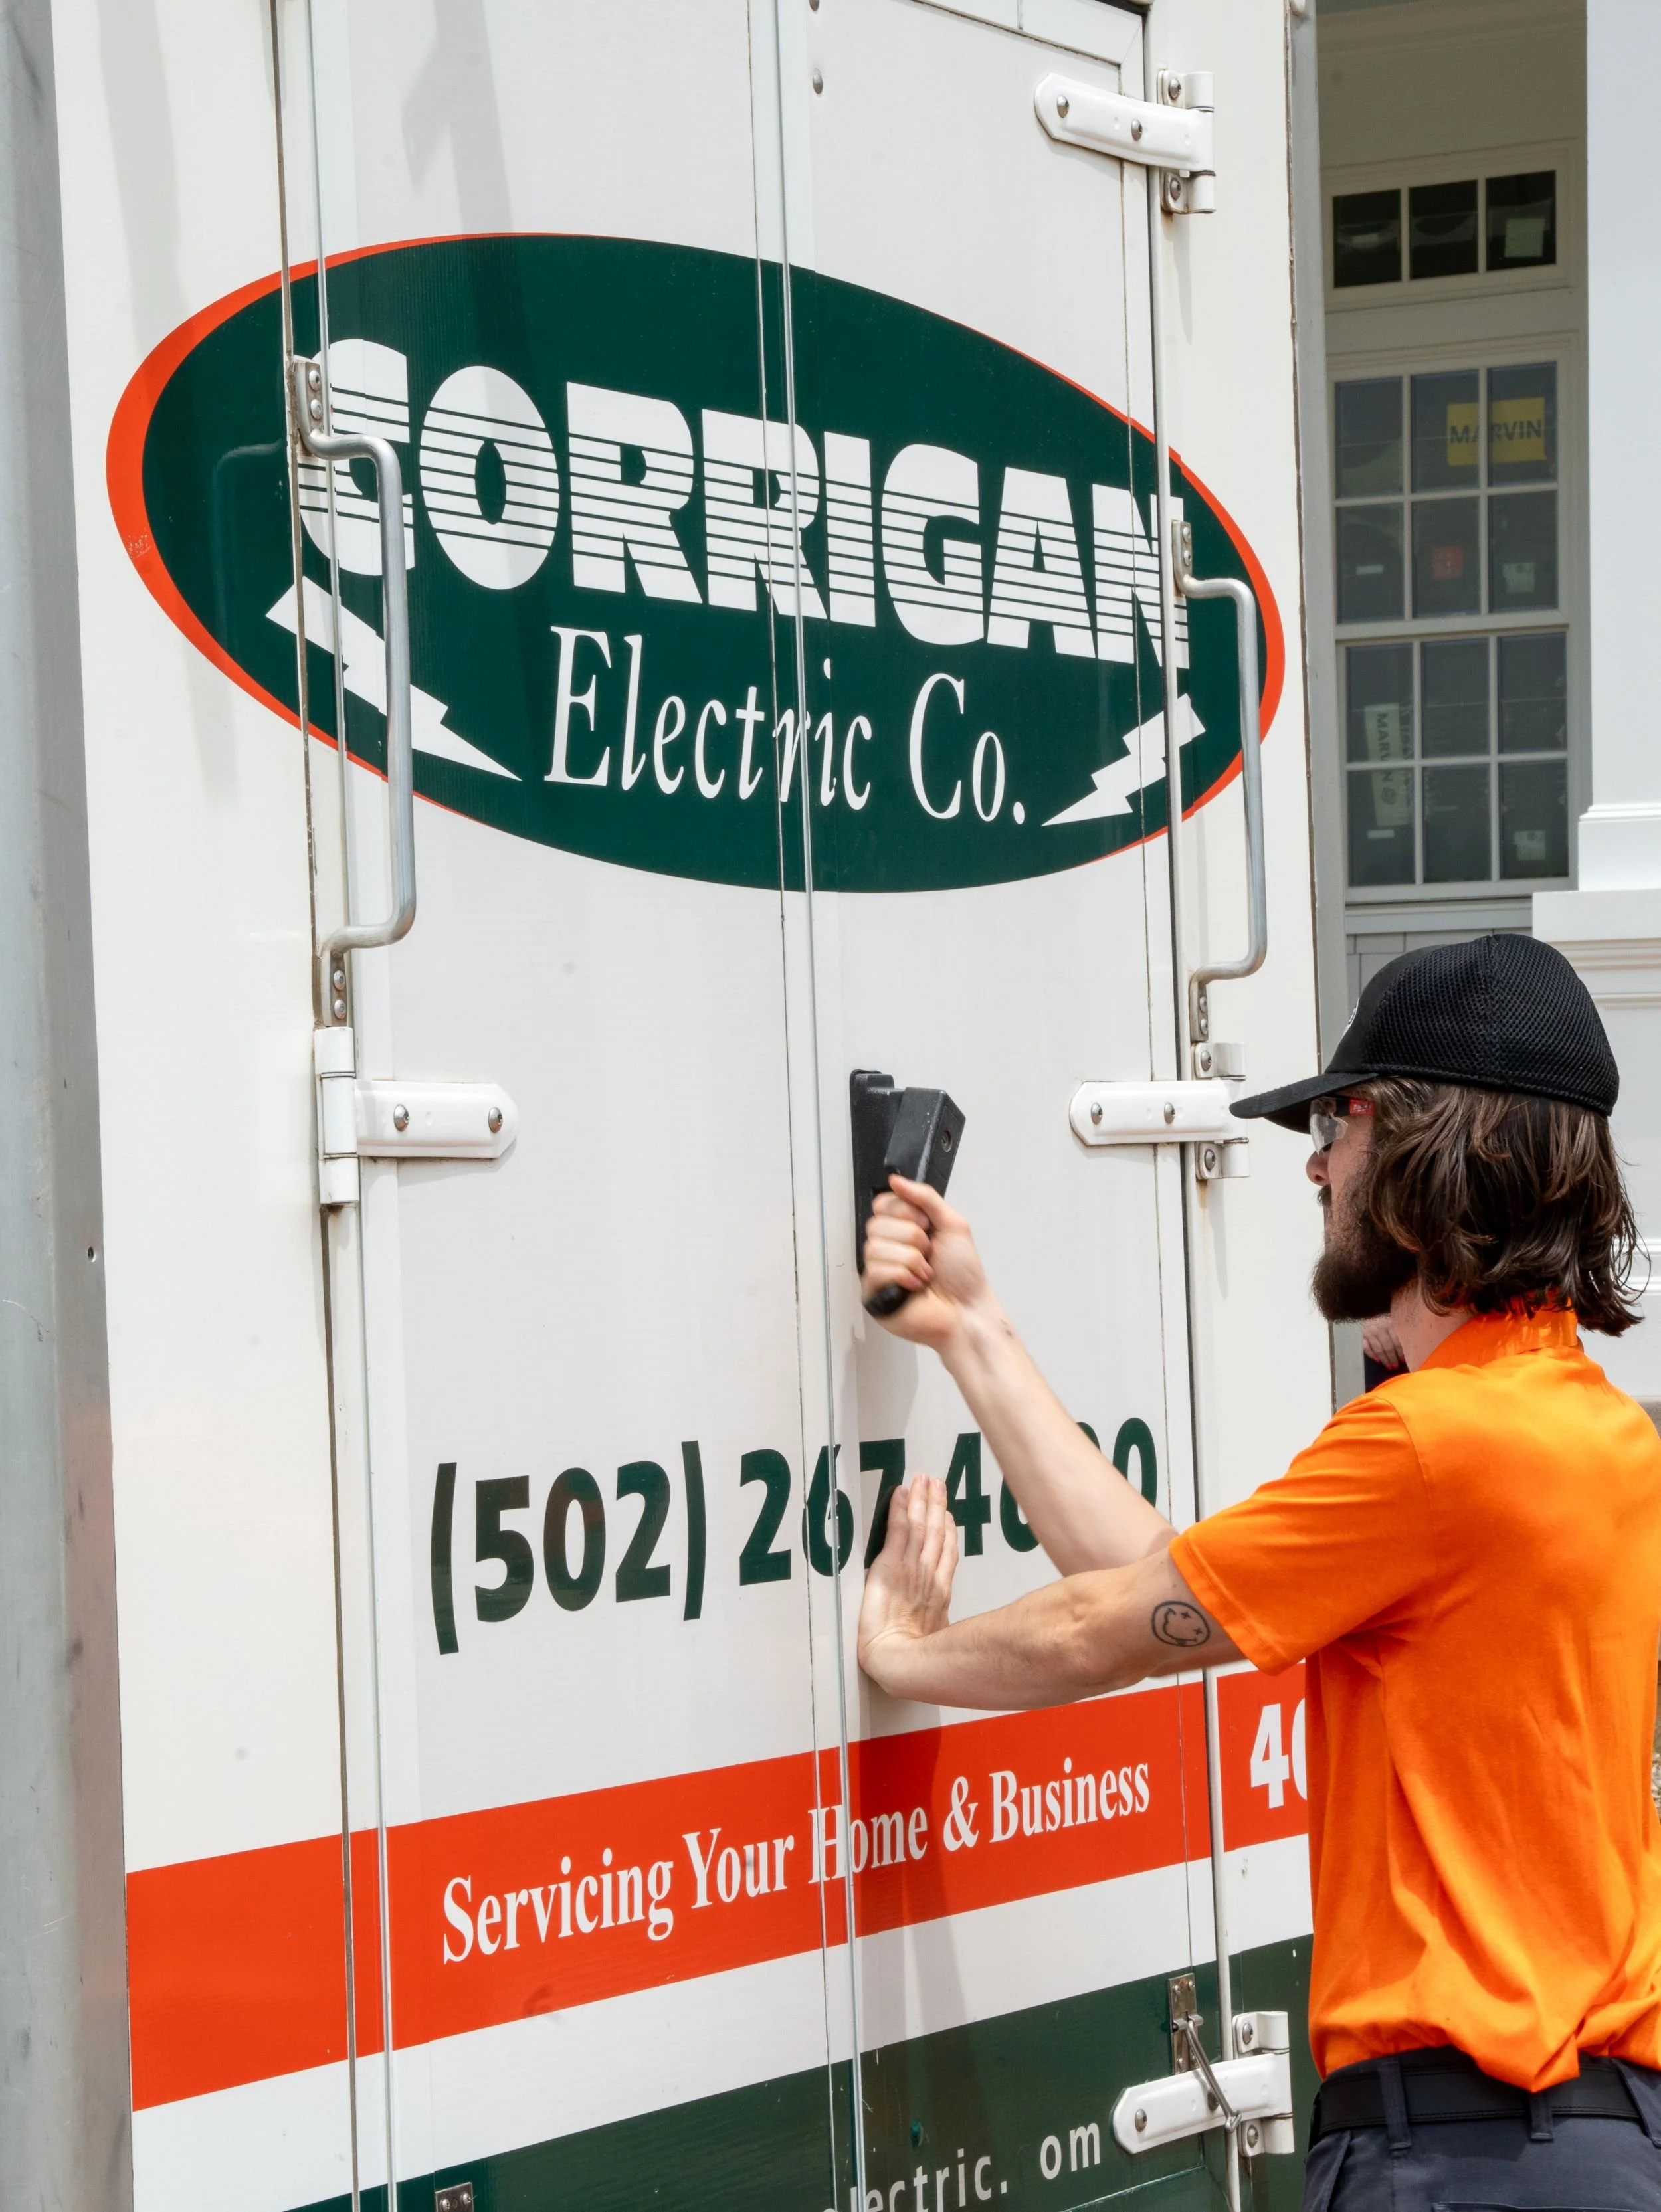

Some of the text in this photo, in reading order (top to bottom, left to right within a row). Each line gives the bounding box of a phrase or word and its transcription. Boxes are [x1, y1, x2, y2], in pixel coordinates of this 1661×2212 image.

[286, 338, 1189, 670] CORRIGAN
[545, 626, 1025, 824] Electric Co.
[1376, 712, 1394, 783] MARVN
[431, 1440, 706, 1655] (502)
[443, 1757, 1150, 1965] Servicing Your Home & Business
